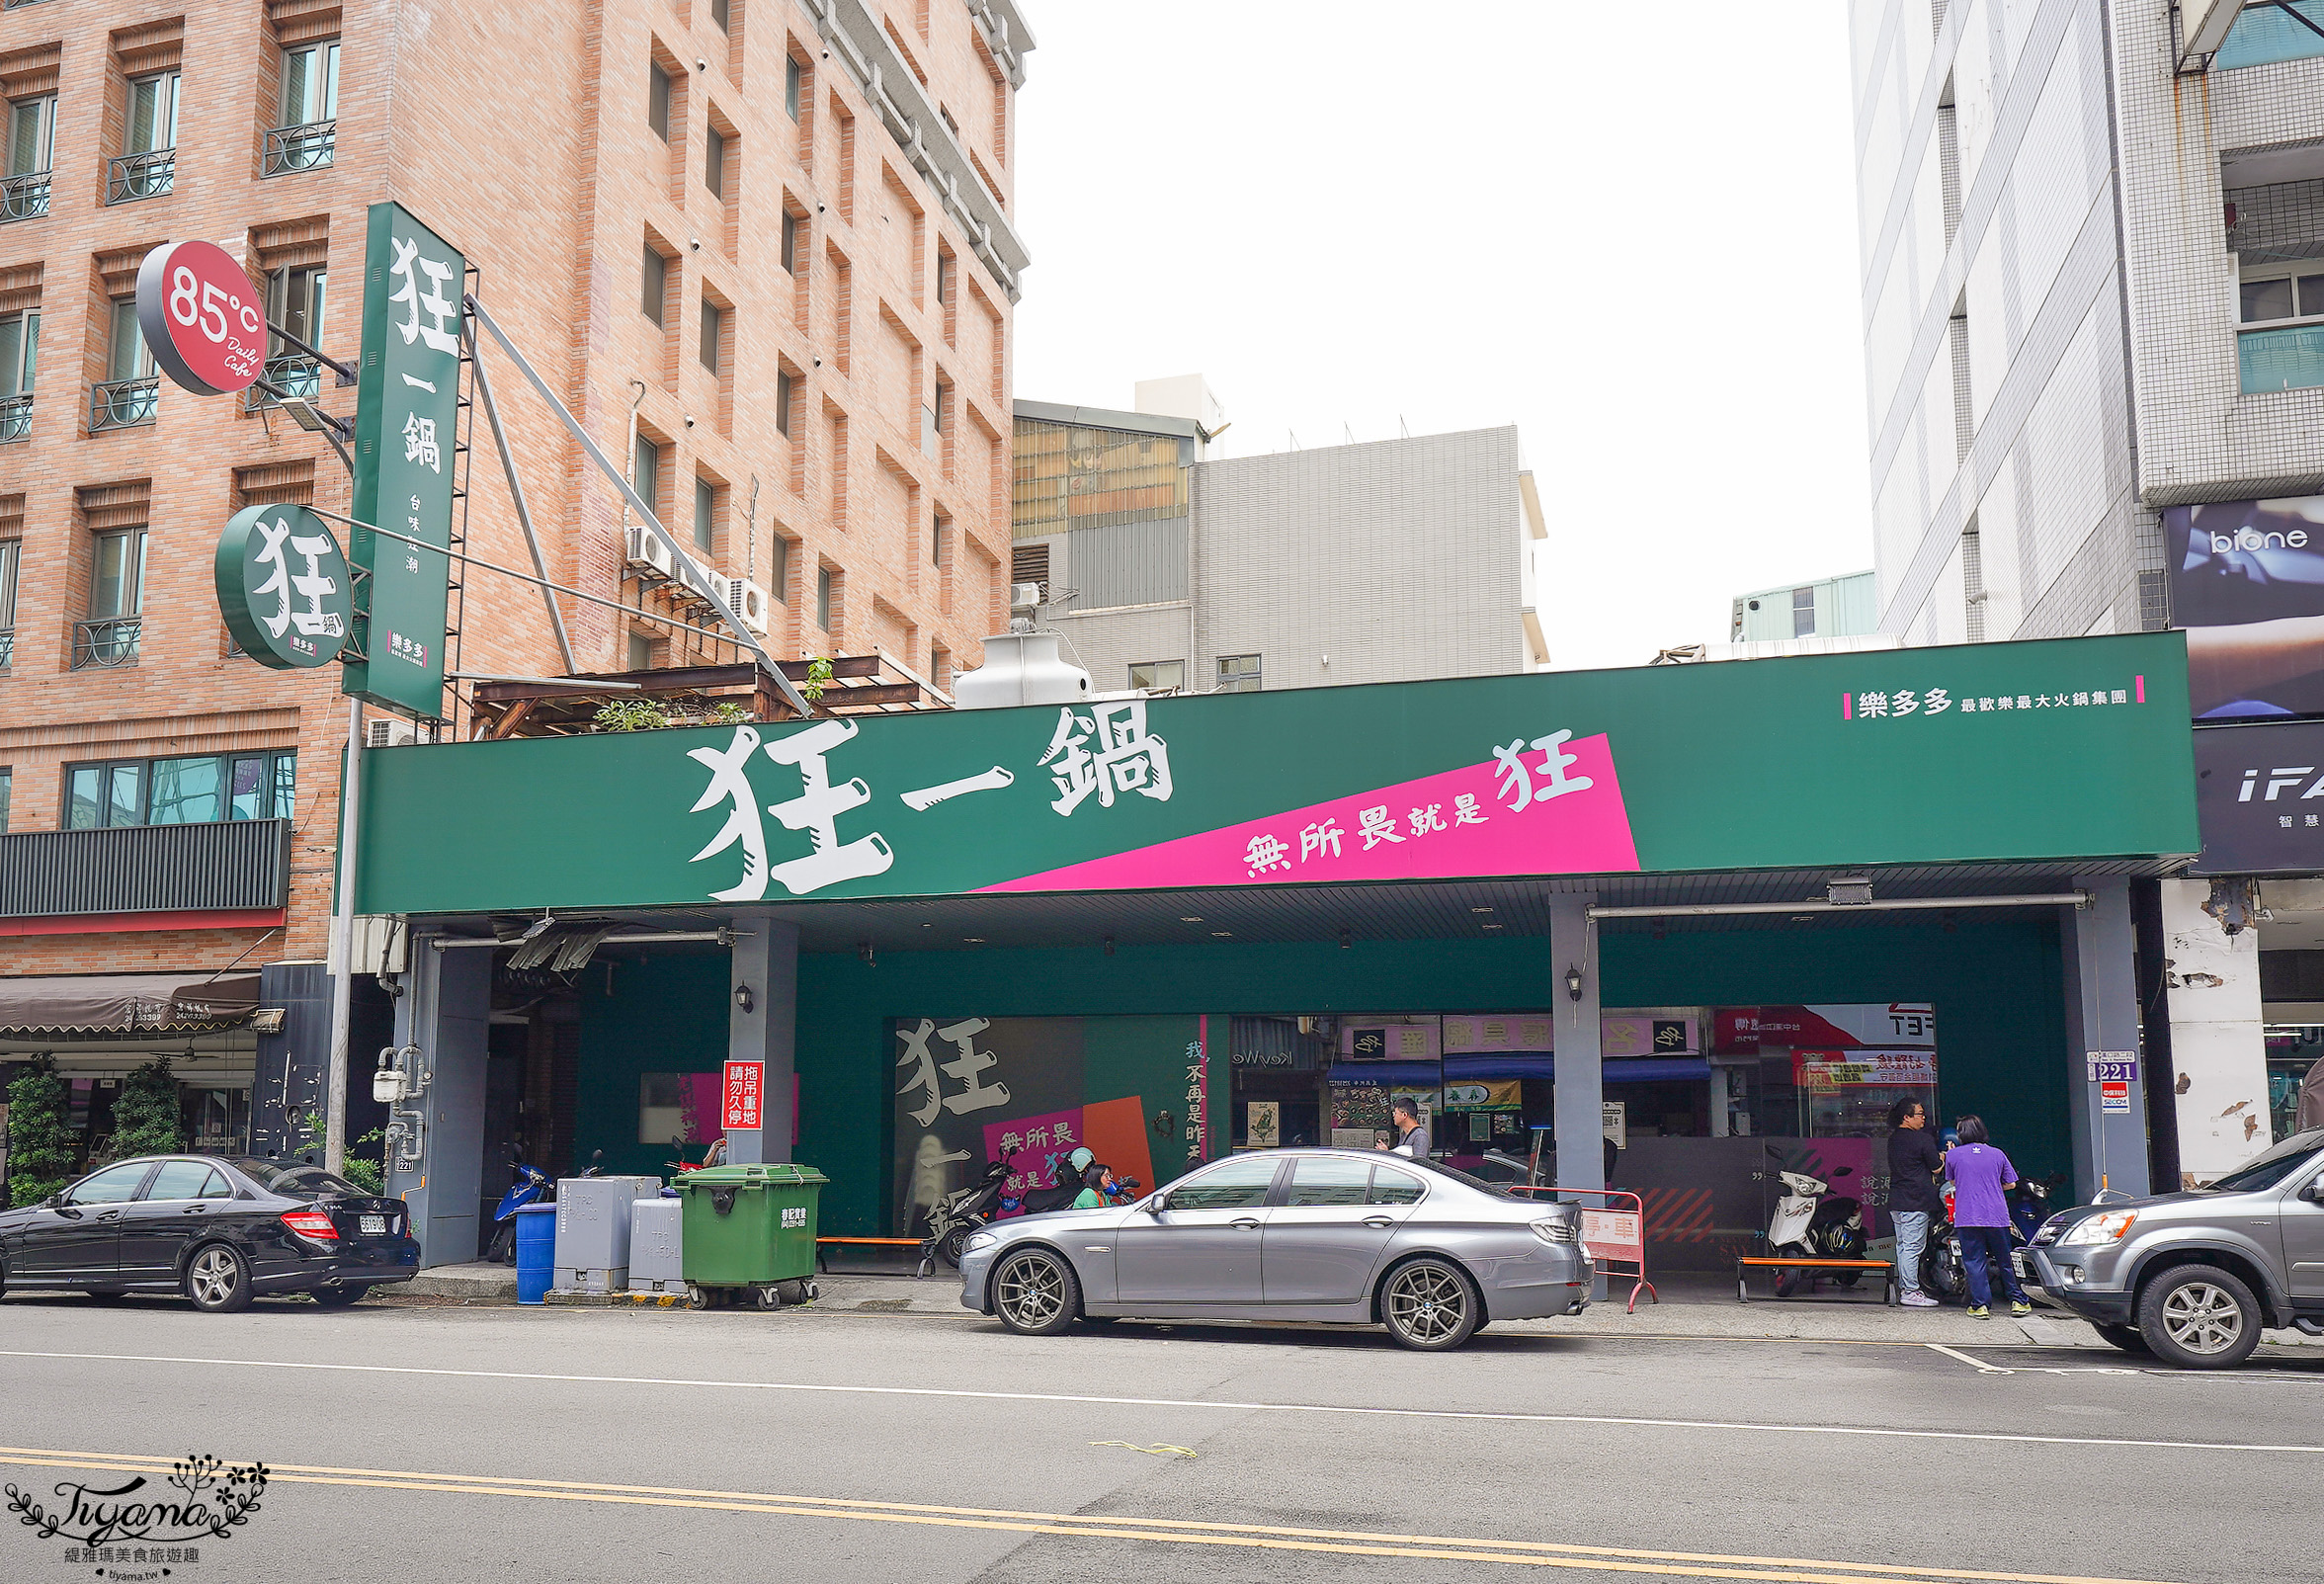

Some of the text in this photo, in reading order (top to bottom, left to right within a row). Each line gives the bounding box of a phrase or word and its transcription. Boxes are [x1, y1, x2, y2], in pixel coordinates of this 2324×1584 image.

[170, 265, 259, 344] 85°C
[223, 355, 253, 377] Cafe
[226, 336, 260, 367] Daily
[388, 236, 460, 475] 狂一鍋
[2210, 528, 2308, 554] bione
[252, 517, 344, 638] 狂
[391, 631, 424, 658] 樂多多
[1859, 688, 2127, 719] 樂多多 最歡樂最大火鍋集團
[686, 699, 1174, 902] 狂一鍋
[1243, 728, 1595, 878] 無所畏就是狂
[2278, 814, 2320, 828] 智慧
[2099, 1063, 2133, 1080] 221
[728, 1066, 744, 1125] 請勿久停
[742, 1066, 759, 1125] 拖吊重地
[999, 1122, 1077, 1155] 無所畏
[399, 1161, 412, 1170] 221
